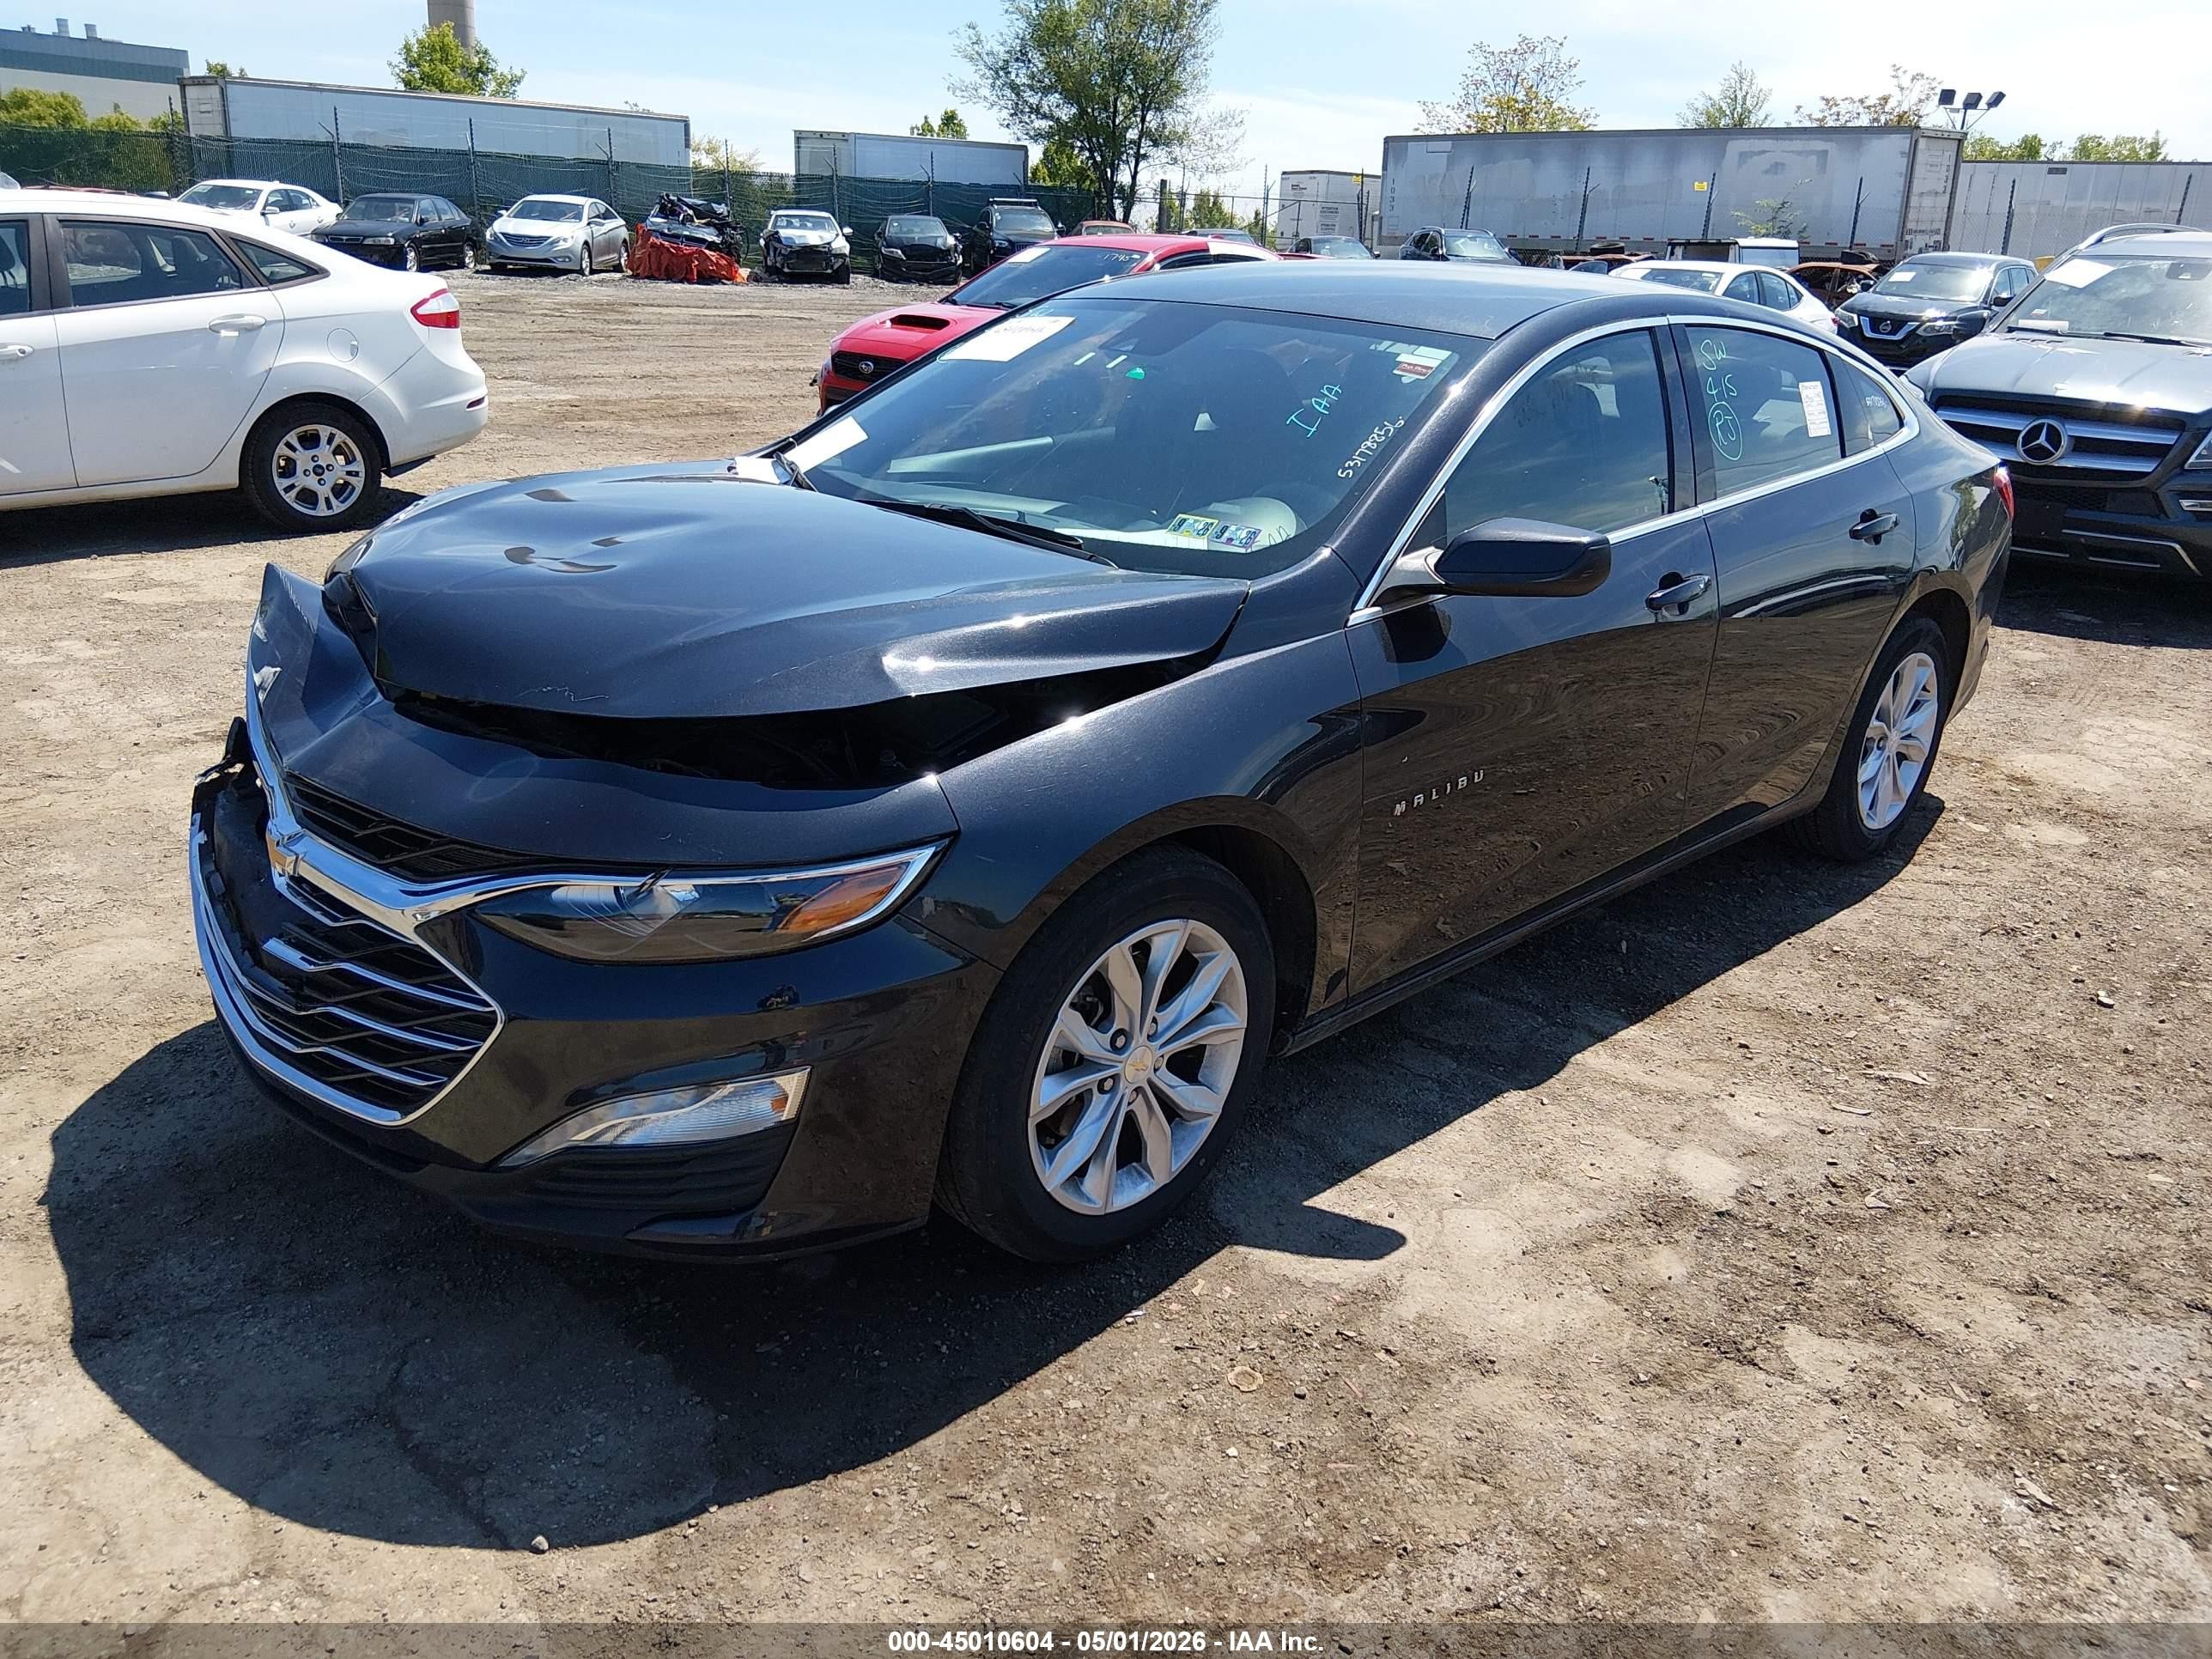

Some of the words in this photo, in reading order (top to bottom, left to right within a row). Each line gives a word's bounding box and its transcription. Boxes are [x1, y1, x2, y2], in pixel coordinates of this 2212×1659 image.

[1286, 383, 1342, 440] IAA
[1173, 518, 1187, 532] 9
[1196, 521, 1214, 536] 26
[1215, 525, 1229, 539] 9
[1239, 530, 1257, 547] 26
[1394, 769, 1485, 817] MALIBU
